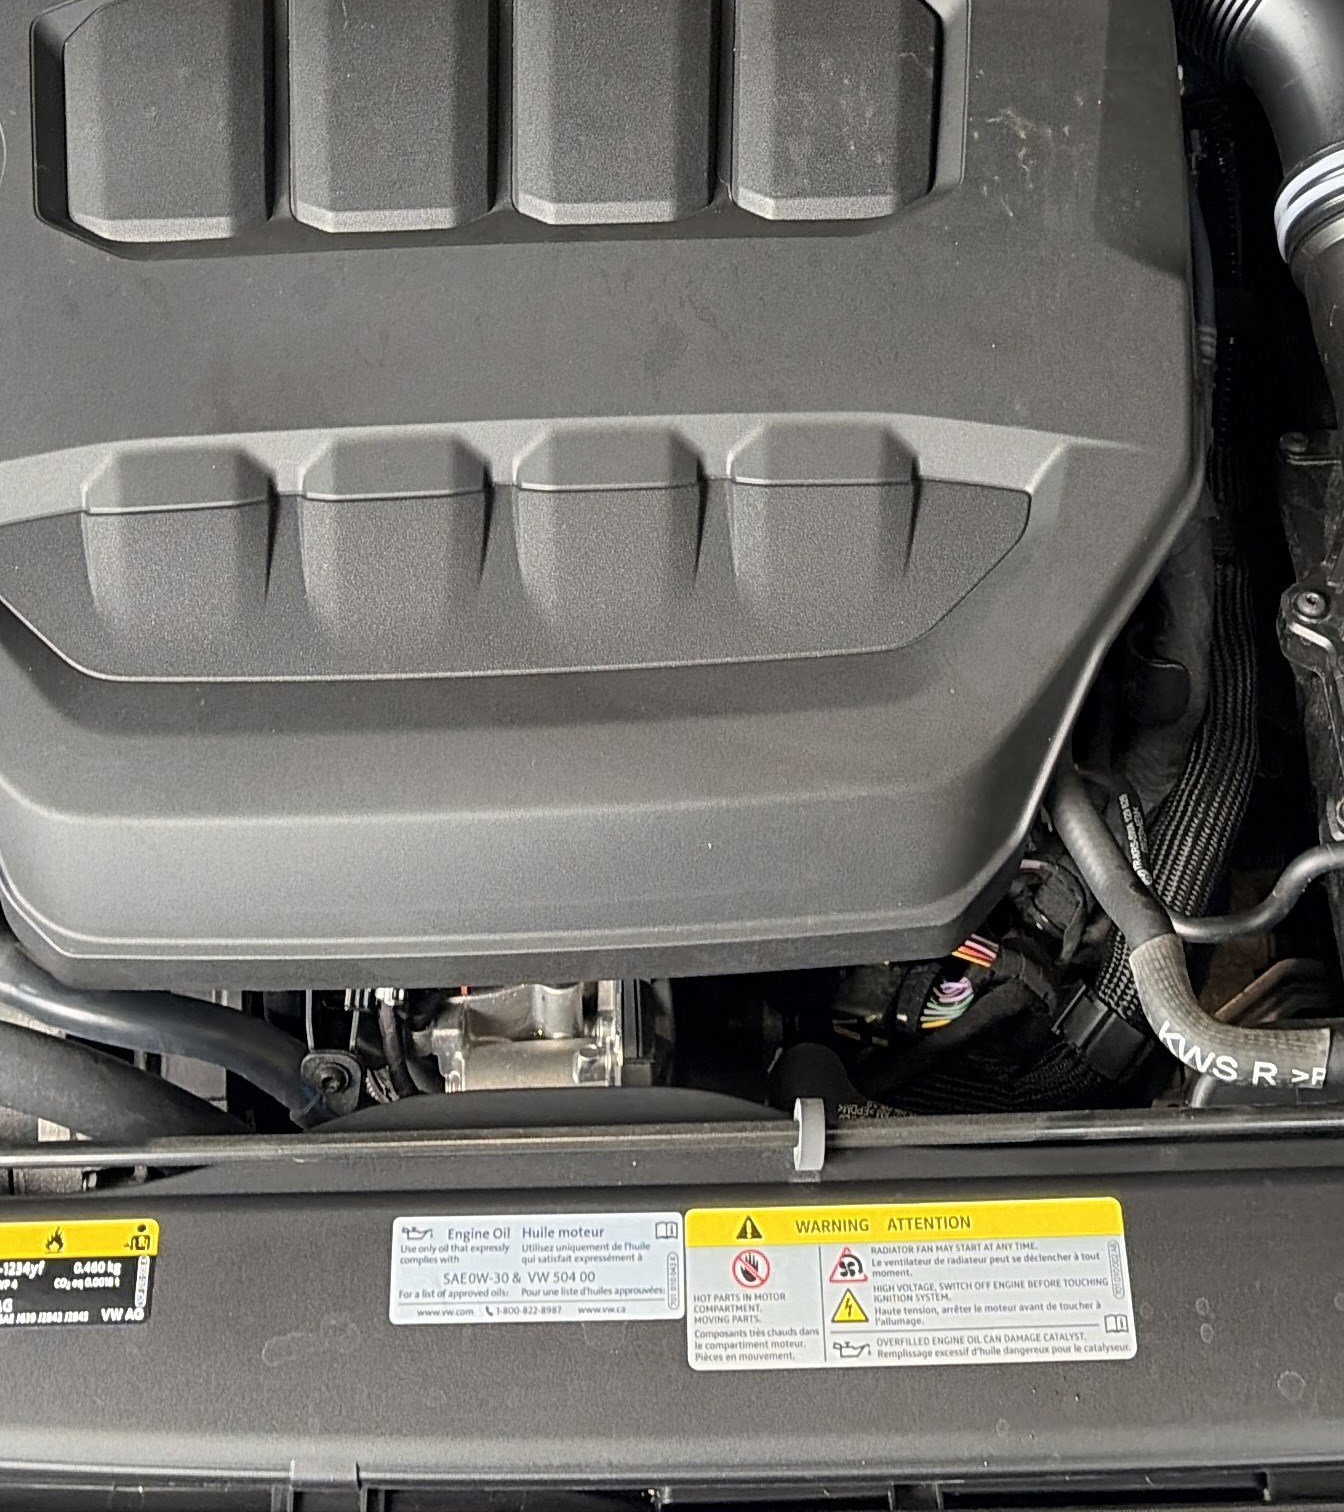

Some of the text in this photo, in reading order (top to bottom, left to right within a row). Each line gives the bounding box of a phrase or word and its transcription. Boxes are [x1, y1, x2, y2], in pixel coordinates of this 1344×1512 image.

[1158, 1020, 1238, 1081] KWS
[1252, 1061, 1277, 1086] R
[795, 1215, 971, 1234] WARNING ATTENTION
[448, 1227, 511, 1243] Engine Oil
[522, 1226, 605, 1238] Huile moteur
[401, 1243, 510, 1254] Use only that expressly
[522, 1242, 622, 1253] Utilisez uniquement de
[871, 1246, 914, 1254] RADIATOR
[917, 1245, 933, 1253] FAN
[936, 1244, 953, 1252] MAY
[1015, 1242, 1038, 1250] TIME.
[400, 1256, 459, 1266] complies with
[522, 1253, 635, 1265] qui satisfait expressément
[872, 1252, 1100, 1267] Le ventilateur de radiateur peut déclencher tout
[108, 1260, 122, 1276] kg
[873, 1269, 912, 1277] moment.
[512, 1272, 521, 1283] &
[528, 1273, 549, 1283] VW
[553, 1272, 575, 1283] 504
[580, 1271, 595, 1282] 00
[873, 1278, 1108, 1292] HIGH SWITCH OFF ENGINE BEFORE TOUCHING
[399, 1288, 489, 1299] For list of approved
[522, 1288, 540, 1297] Pour
[561, 1288, 578, 1296] liste
[694, 1293, 786, 1302] HOT PARTS IN MOTOR
[874, 1295, 913, 1303] IGNITION
[694, 1304, 762, 1313] COMPARTMENT.
[875, 1301, 1093, 1316] Haute tension, arrêter moteur avant de toucher
[101, 1308, 144, 1322] VW AG
[695, 1314, 761, 1324] MOVING PARTS.
[695, 1326, 819, 1340] Composants très chauds dans
[705, 1340, 806, 1351] compartiment moteur.
[877, 1332, 1087, 1347] OVERFILLED ENGINE OIL CAN DAMAGE CATALYST.
[695, 1352, 723, 1362] Pièces
[739, 1352, 796, 1361] mouvement.
[878, 1343, 1131, 1360] Remplissage excessif dangereux pour catalyseur.
